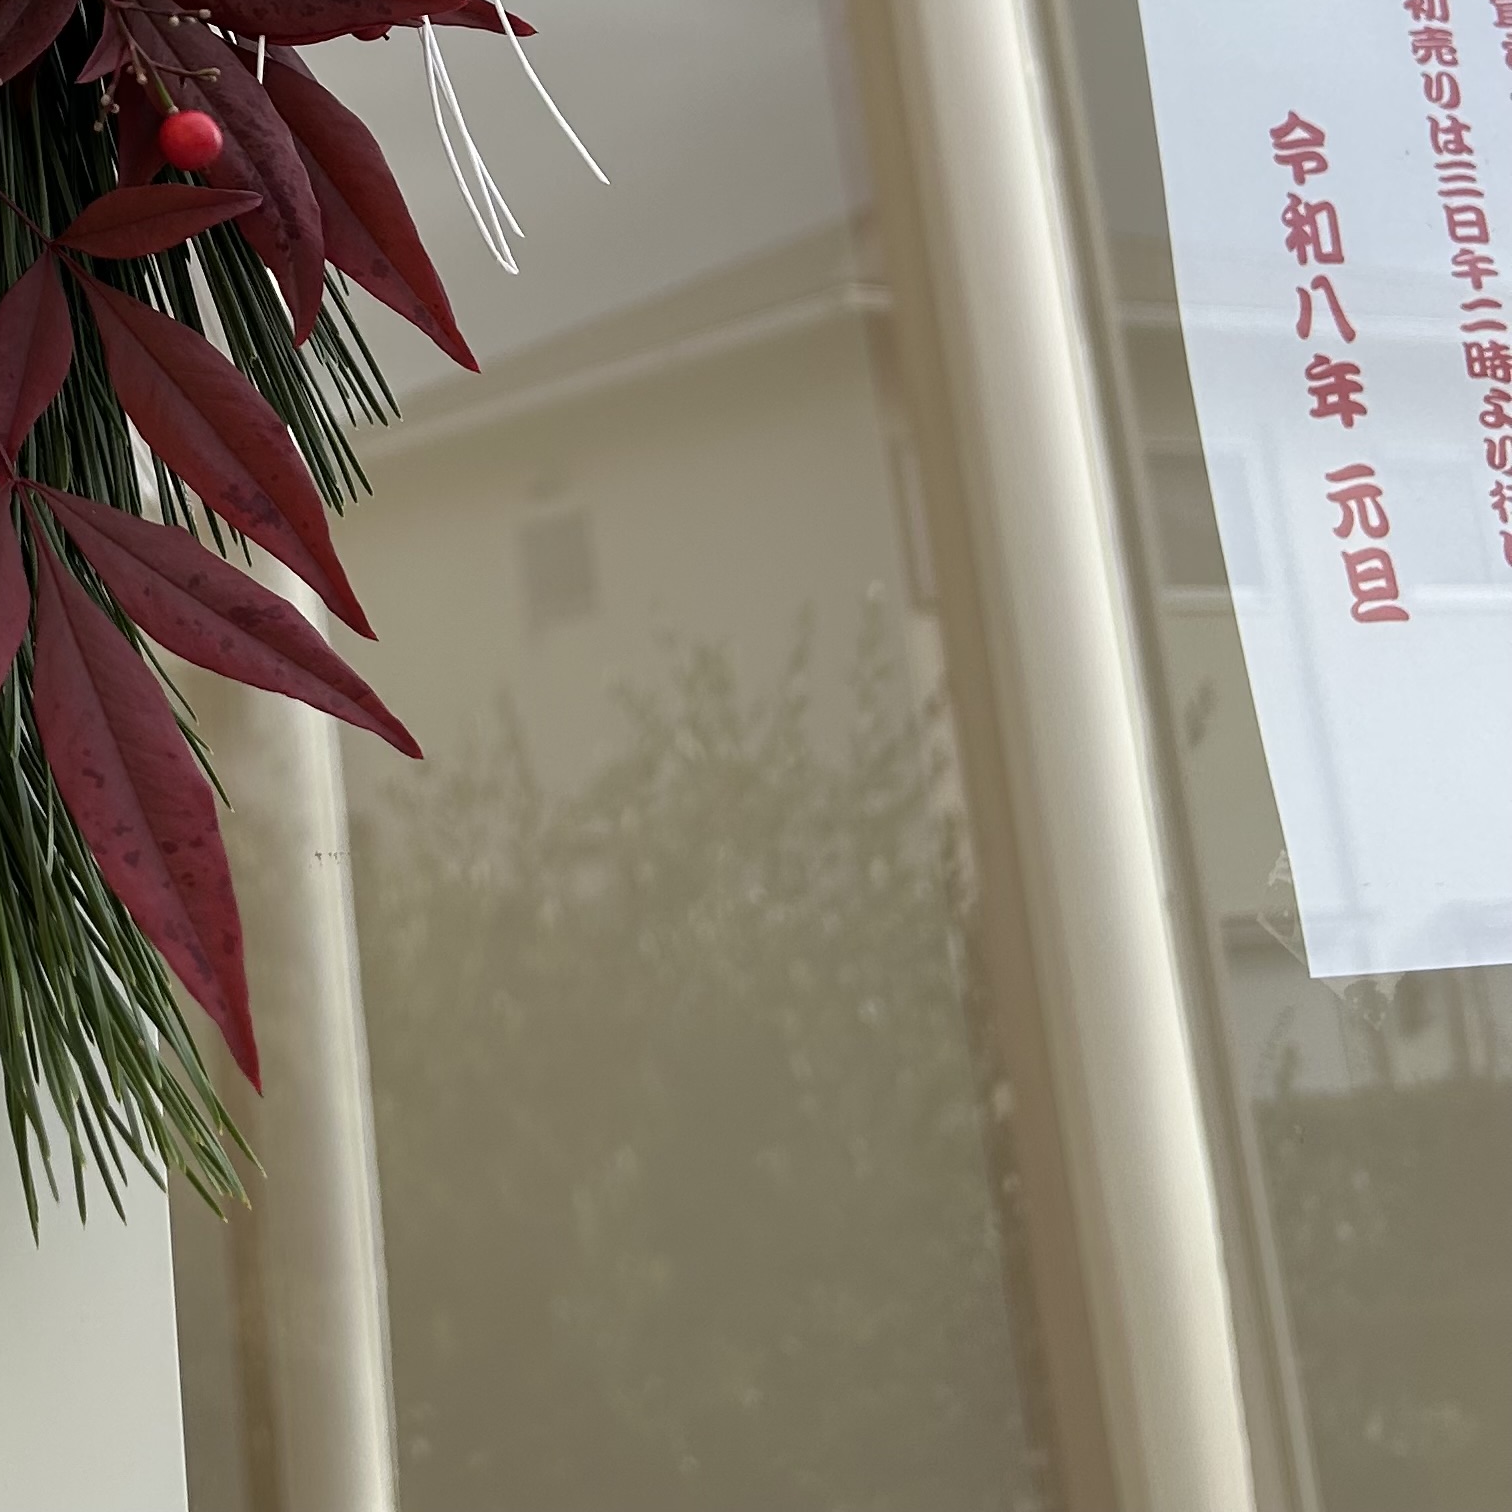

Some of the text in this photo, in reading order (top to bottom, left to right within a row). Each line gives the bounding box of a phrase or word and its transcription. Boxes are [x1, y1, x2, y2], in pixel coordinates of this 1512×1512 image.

[1269, 110, 1410, 624] 令和八年 元旦
